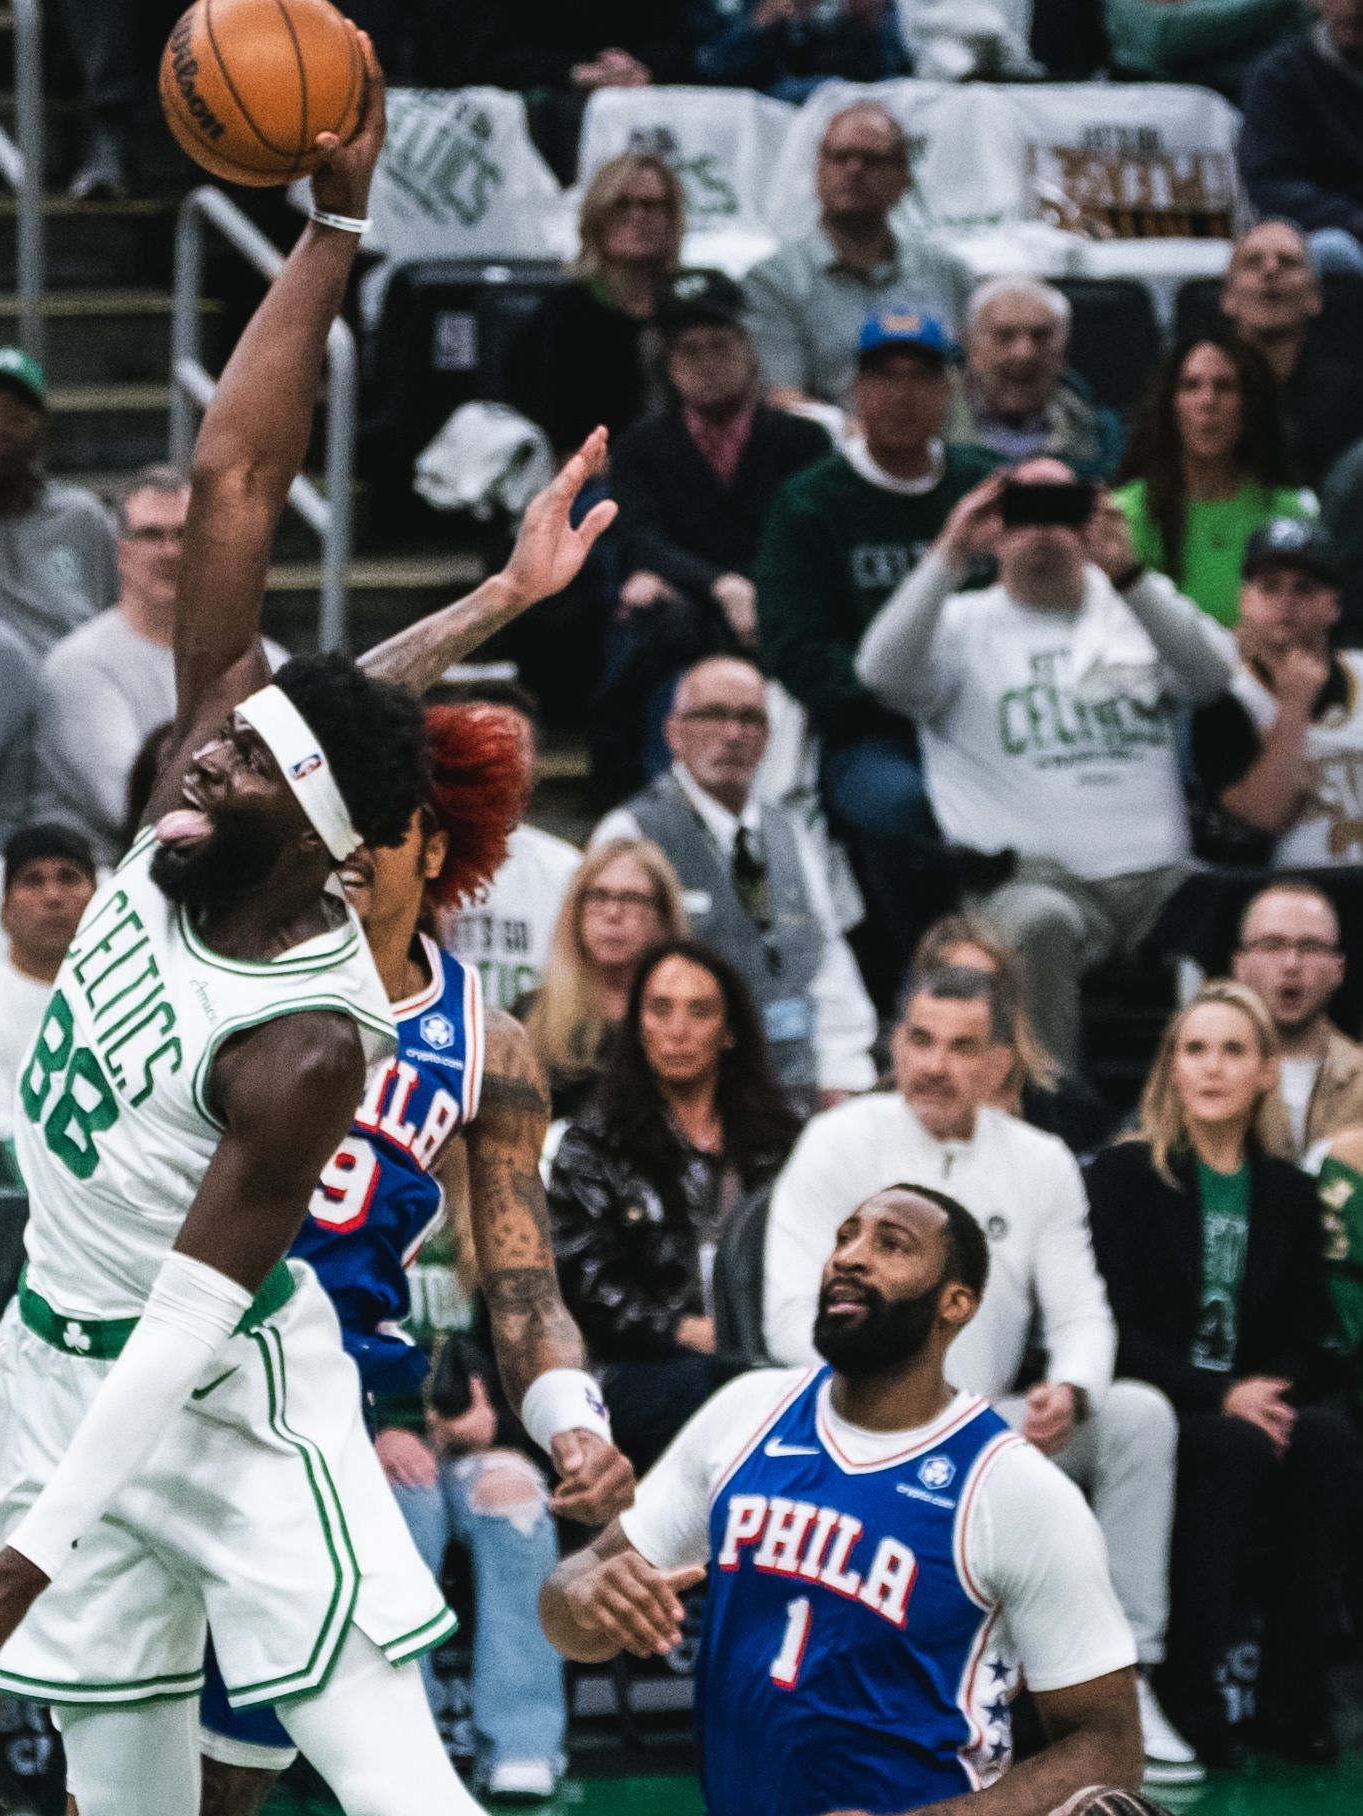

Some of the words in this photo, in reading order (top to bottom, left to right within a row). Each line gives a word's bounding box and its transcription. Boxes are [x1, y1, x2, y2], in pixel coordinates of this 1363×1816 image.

[65, 889, 183, 1109] CELTICS
[19, 988, 120, 1181] 88
[354, 1055, 461, 1174] ILA
[405, 1048, 465, 1072] crypto.com
[307, 1135, 381, 1234] 9
[718, 1493, 919, 1631] PHILA
[769, 1596, 813, 1692] 1
